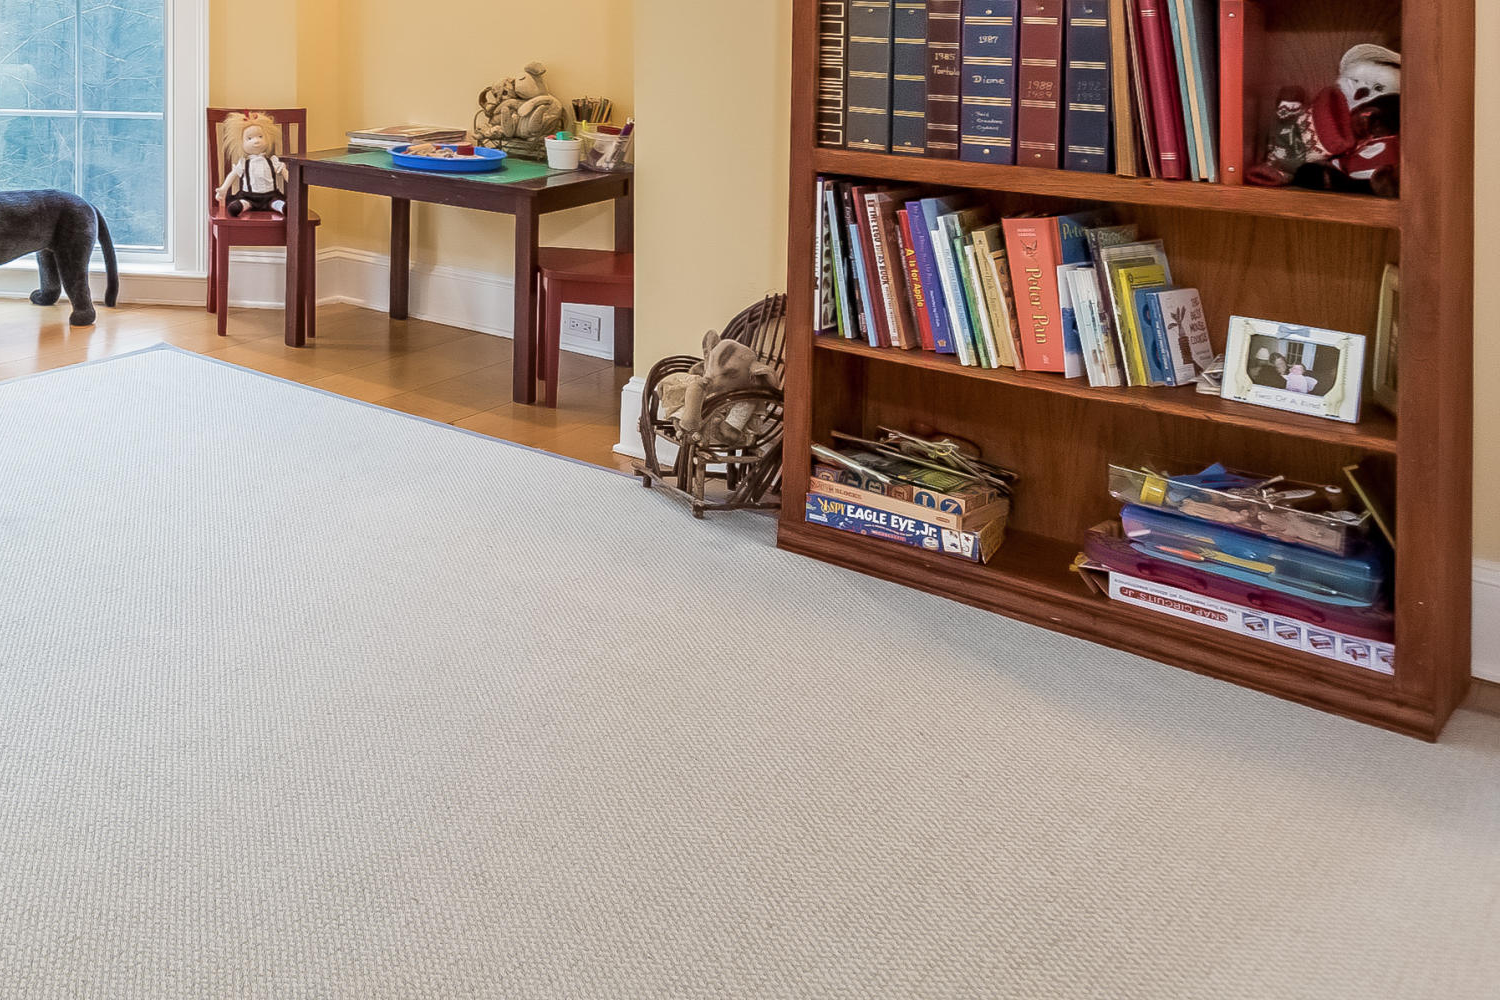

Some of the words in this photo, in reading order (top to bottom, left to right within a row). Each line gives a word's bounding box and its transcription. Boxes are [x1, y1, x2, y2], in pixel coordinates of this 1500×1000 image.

[978, 35, 999, 44] 1987
[905, 248, 915, 257] A
[911, 268, 919, 281] for
[914, 283, 925, 308] Apple
[1024, 266, 1043, 310] Peter
[1032, 313, 1050, 344] Pan
[846, 504, 887, 525] EAGLE
[1140, 593, 1193, 613] CIRCUITS
[1196, 608, 1228, 622] SNAP
